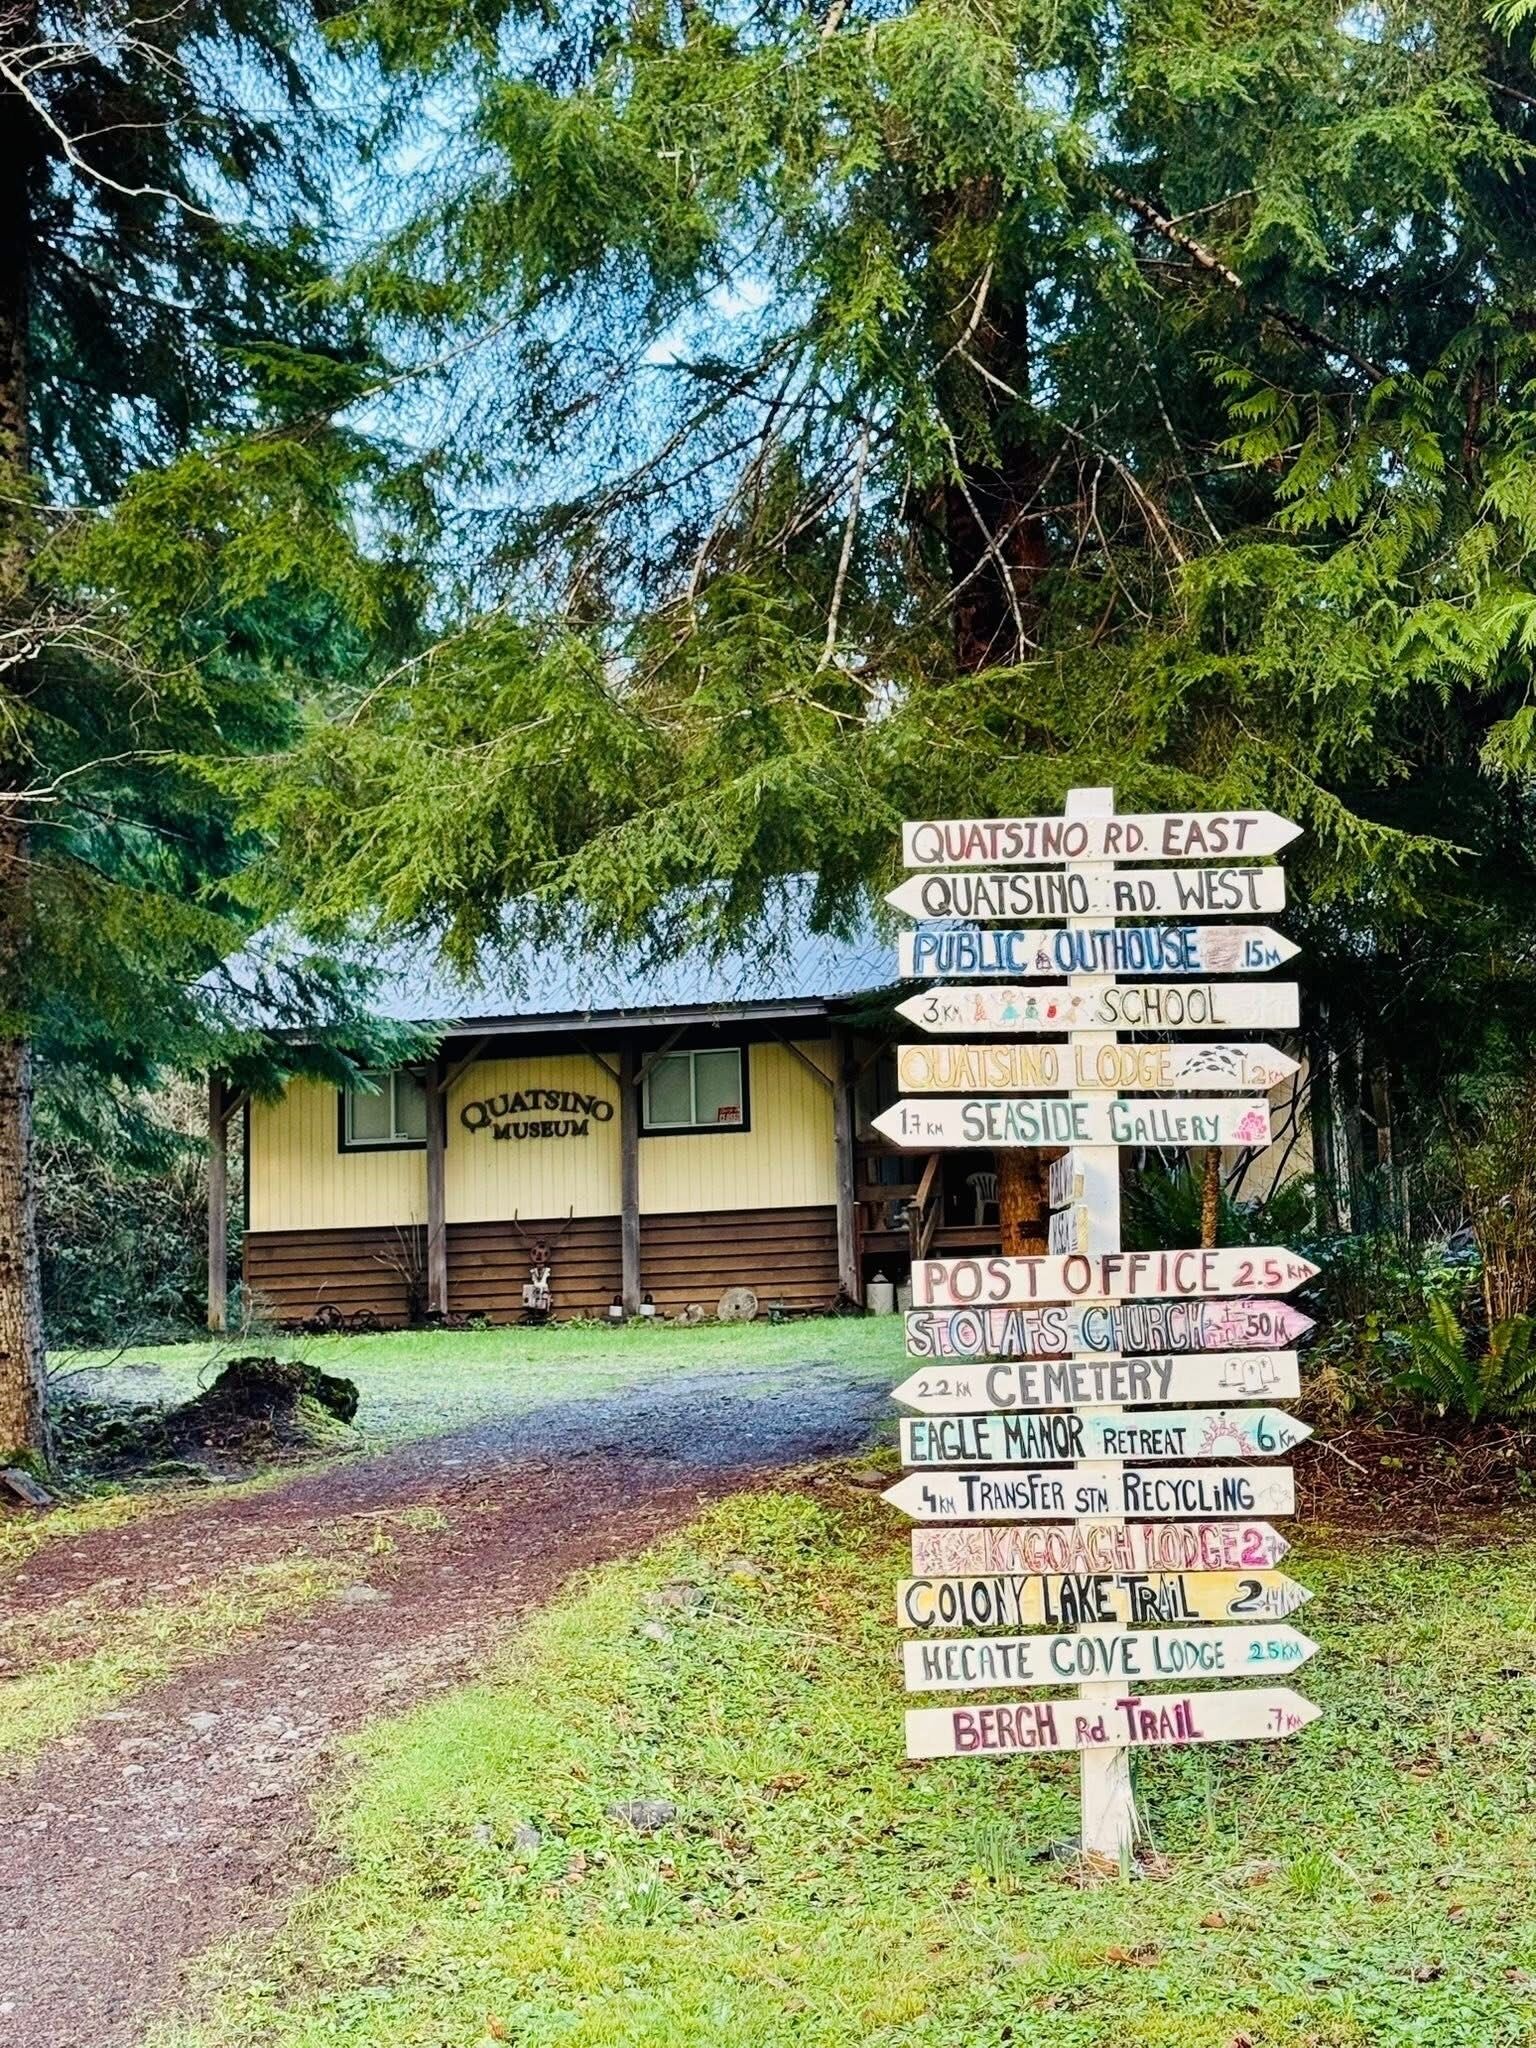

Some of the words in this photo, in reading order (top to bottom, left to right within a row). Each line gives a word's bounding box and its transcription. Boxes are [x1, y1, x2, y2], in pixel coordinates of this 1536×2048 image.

[912, 822, 1088, 863] QUATSINO
[1162, 818, 1258, 856] EAST
[921, 874, 1089, 917] QUATSINO
[1114, 880, 1161, 911] RD.
[1175, 869, 1263, 912] WEST
[912, 929, 1028, 974] PUBLIC
[1054, 926, 1201, 972] OUTHOUSE
[1099, 986, 1226, 1026] SCHOOL
[899, 1044, 1059, 1089] QUATSINO
[1074, 1044, 1174, 1088] LODGE
[460, 1089, 614, 1134] QUATSINO
[492, 1119, 589, 1141] MUSEUM
[1110, 1101, 1220, 1143] GALLERY
[924, 1257, 1045, 1303] POST
[1062, 1252, 1222, 1296] OFFICE
[1082, 1303, 1205, 1352] CHURCH
[985, 1359, 1174, 1406] CEMETERY
[910, 1417, 993, 1462] EAGLE
[1002, 1415, 1087, 1460] MANOR
[1103, 1427, 1186, 1456] RETREAT
[958, 1472, 1065, 1513] TRANSFER
[1142, 1523, 1241, 1570] LODGE
[905, 1575, 1026, 1628] COLONY
[1042, 1574, 1118, 1625] LAKE
[921, 1641, 1034, 1682] HECATE
[1050, 1636, 1140, 1677] COVE
[1153, 1635, 1226, 1674] LODGE
[952, 1703, 1058, 1752] BERGH
